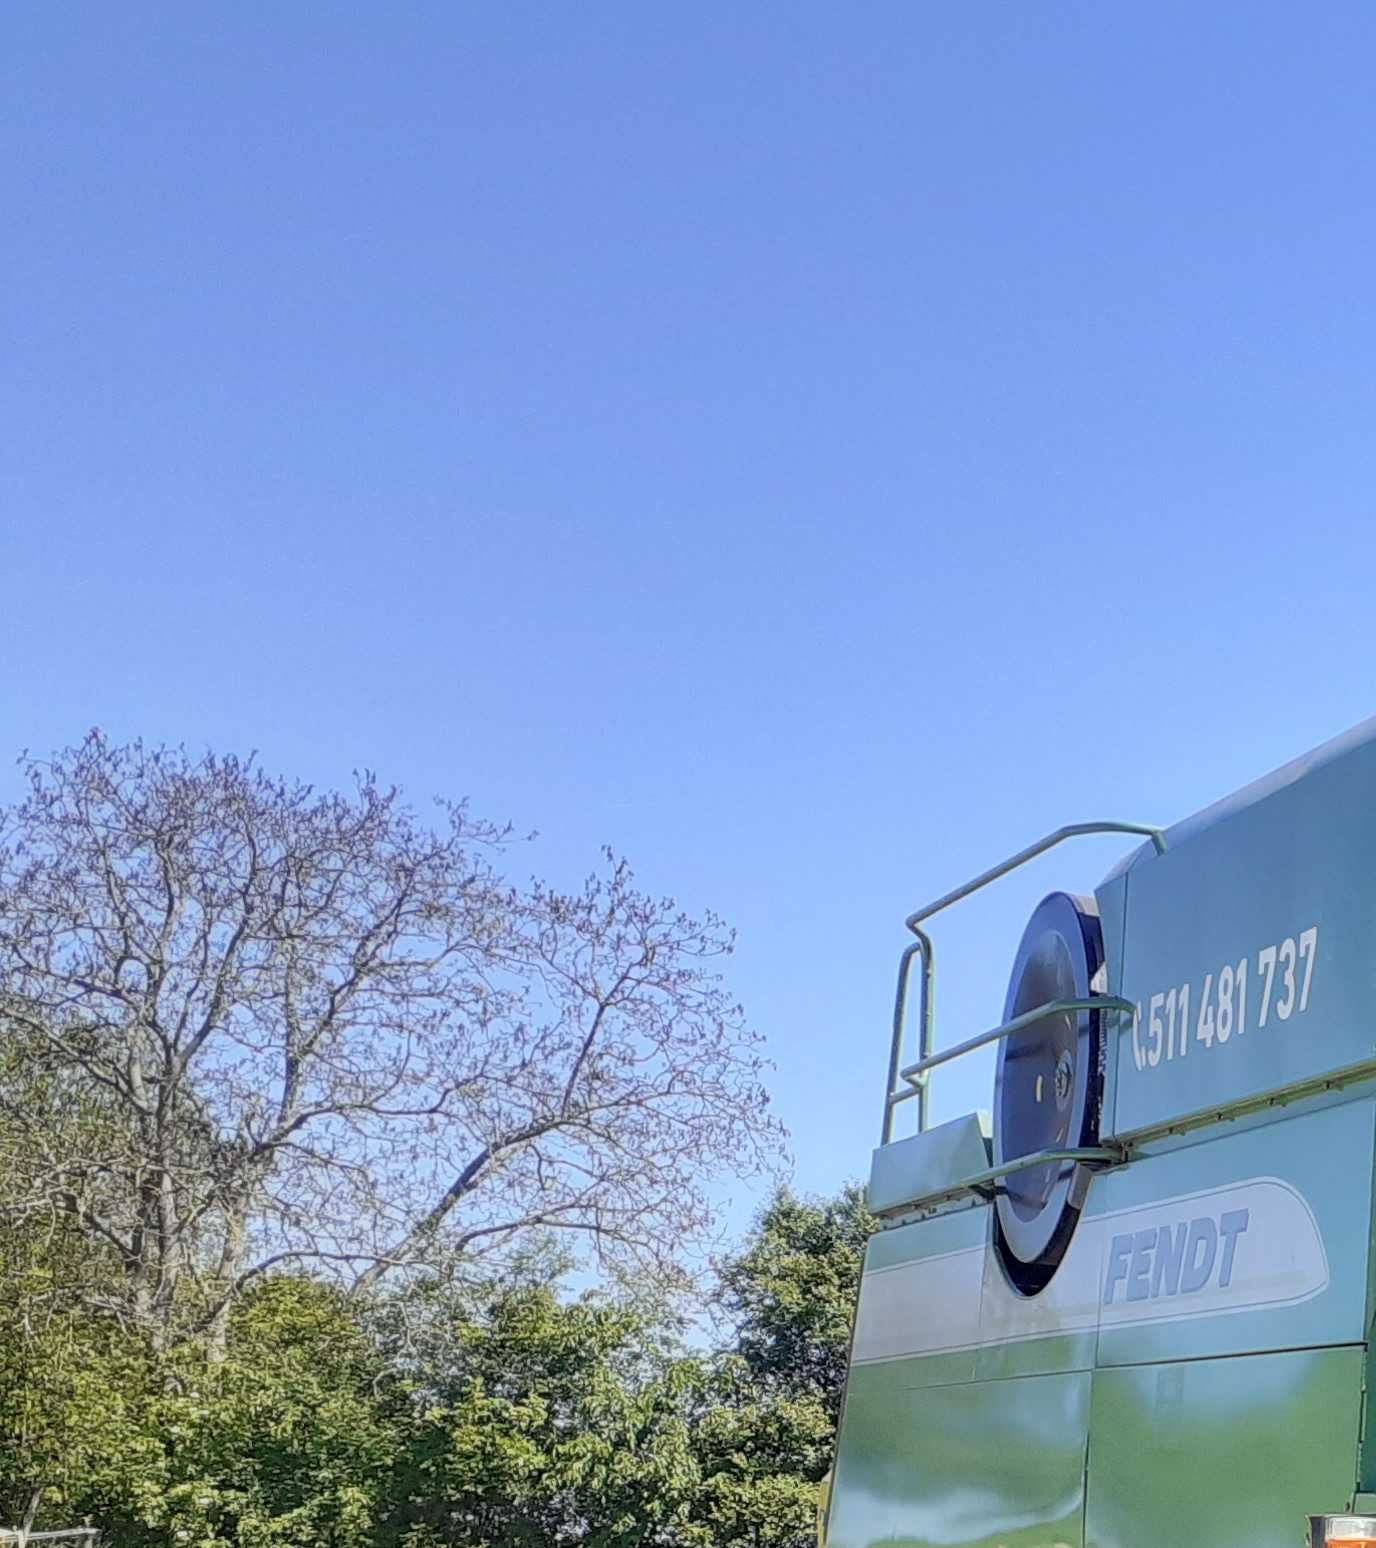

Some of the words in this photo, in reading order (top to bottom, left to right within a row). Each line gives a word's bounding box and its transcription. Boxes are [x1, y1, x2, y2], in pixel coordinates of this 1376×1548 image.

[1196, 957, 1248, 1048] 481
[1258, 926, 1318, 1028] 737
[1104, 1208, 1249, 1306] FENDT
